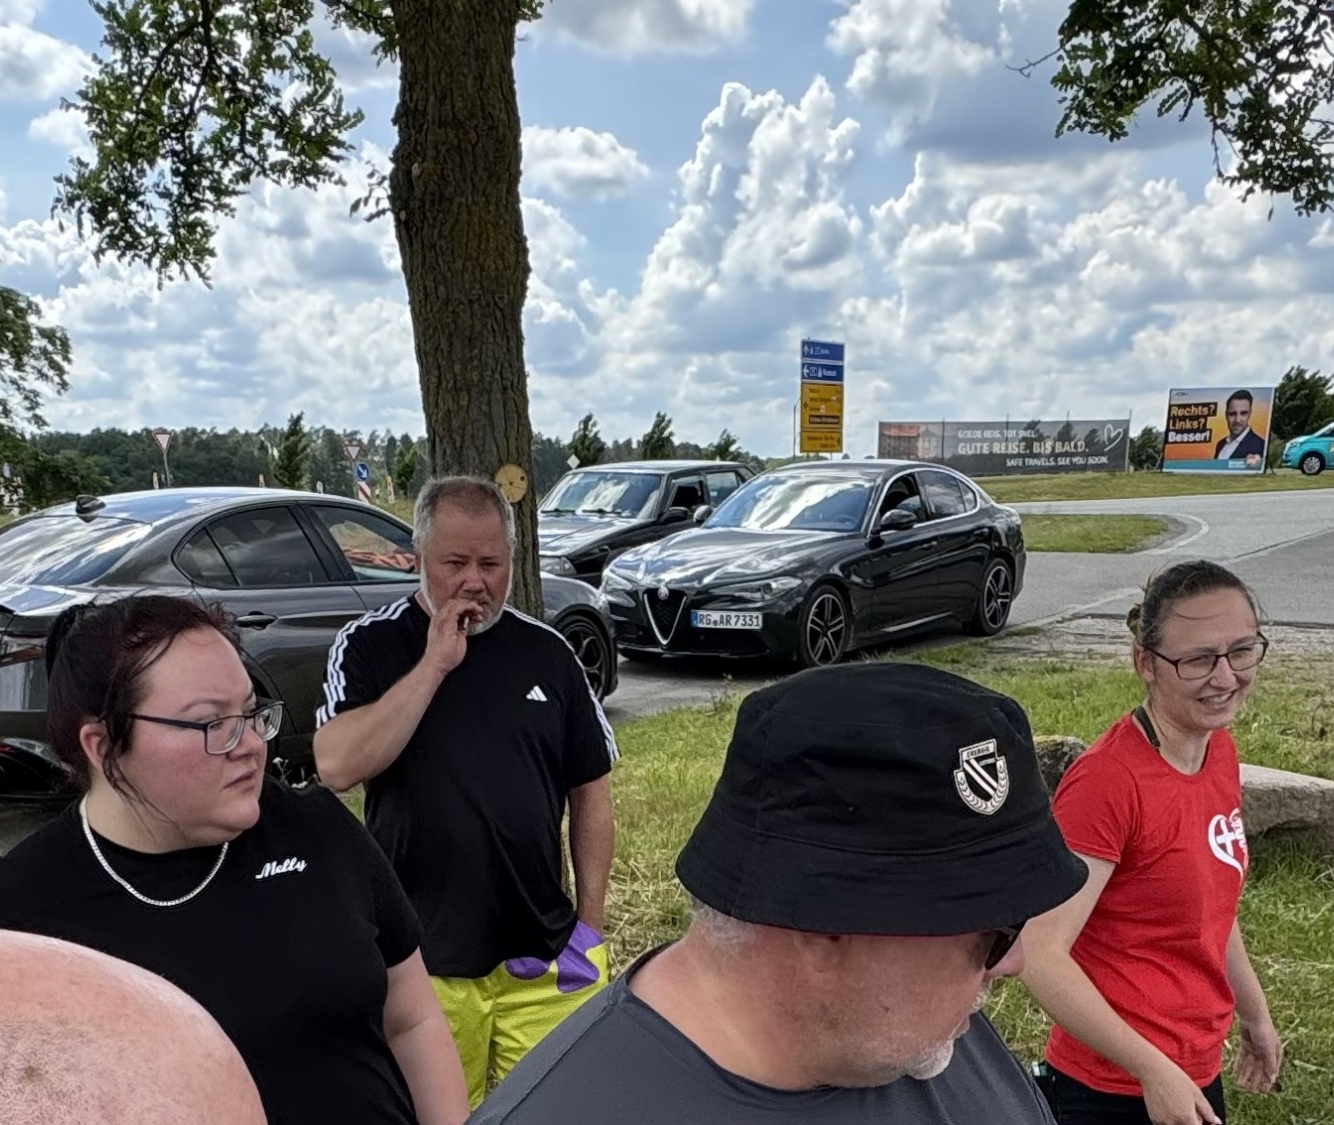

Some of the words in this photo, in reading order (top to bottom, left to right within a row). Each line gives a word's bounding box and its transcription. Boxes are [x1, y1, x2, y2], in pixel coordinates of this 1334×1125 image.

[1170, 404, 1216, 417] Rechts?
[1169, 418, 1205, 430] Links?
[1168, 431, 1211, 443] Besser!
[958, 442, 990, 455] GUTE
[992, 441, 1030, 454] REISE.
[1032, 441, 1052, 454] BIS
[1055, 440, 1089, 453] BALD.
[699, 613, 712, 626] RG
[719, 614, 732, 627] AR
[734, 614, 761, 627] 7331
